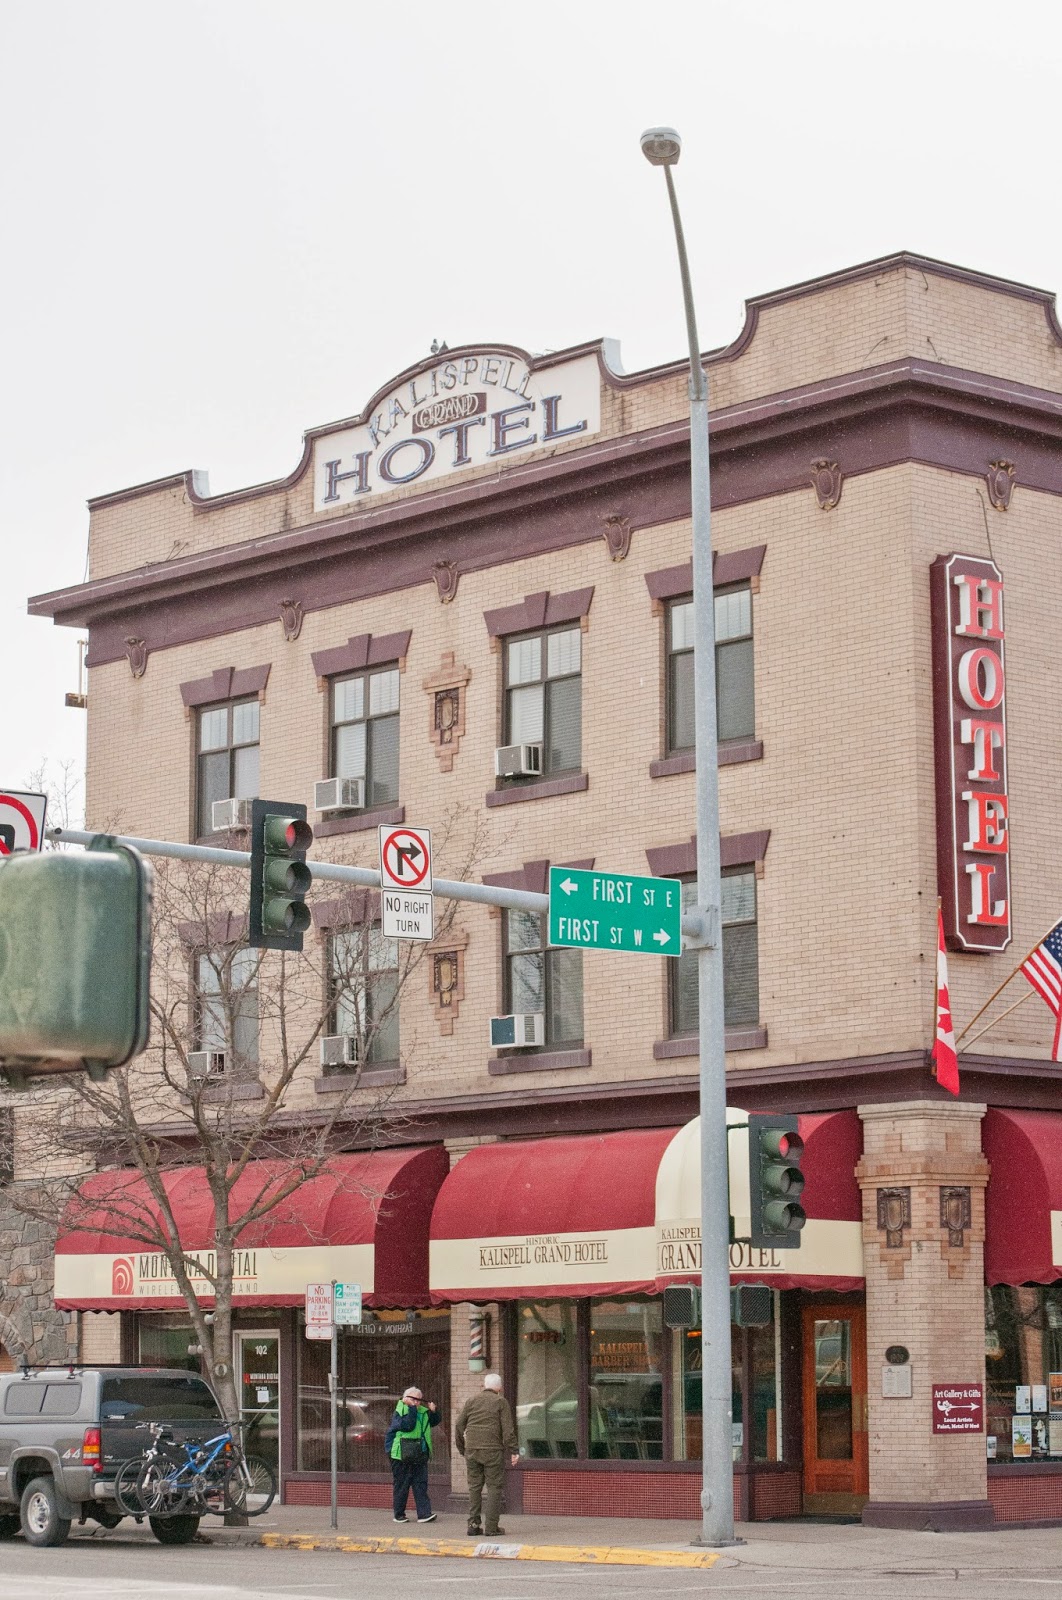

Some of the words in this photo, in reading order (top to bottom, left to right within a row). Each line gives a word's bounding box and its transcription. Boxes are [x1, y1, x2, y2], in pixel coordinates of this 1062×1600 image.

[366, 355, 533, 449] KALISPELL
[415, 393, 479, 428] GRAND
[322, 394, 587, 504] HOTEL
[954, 574, 1008, 926] HOTEL
[593, 878, 633, 904] FIRST
[643, 889, 655, 906] ST
[666, 891, 673, 908] E
[386, 897, 401, 912] NO
[404, 901, 429, 914] RIGHT
[396, 919, 420, 932] TURN
[559, 917, 599, 942] FIRST
[610, 926, 623, 944] ST
[634, 929, 643, 946] W
[526, 1236, 560, 1246] HISTORIC
[661, 1227, 702, 1240] KALISPEL
[480, 1247, 531, 1266] KALISPELL
[534, 1245, 571, 1263] GRAND
[574, 1242, 608, 1261] HOTEL
[661, 1242, 702, 1271] GRAN
[728, 1241, 780, 1268] OTEL
[140, 1254, 202, 1278] MONNA
[308, 1296, 331, 1304] PARKING
[314, 1287, 324, 1295] NO
[336, 1287, 343, 1297] 2
[255, 1345, 268, 1355] 102
[934, 1390, 944, 1398] Art
[944, 1389, 963, 1399] Gallery
[969, 1389, 981, 1398] Gifts
